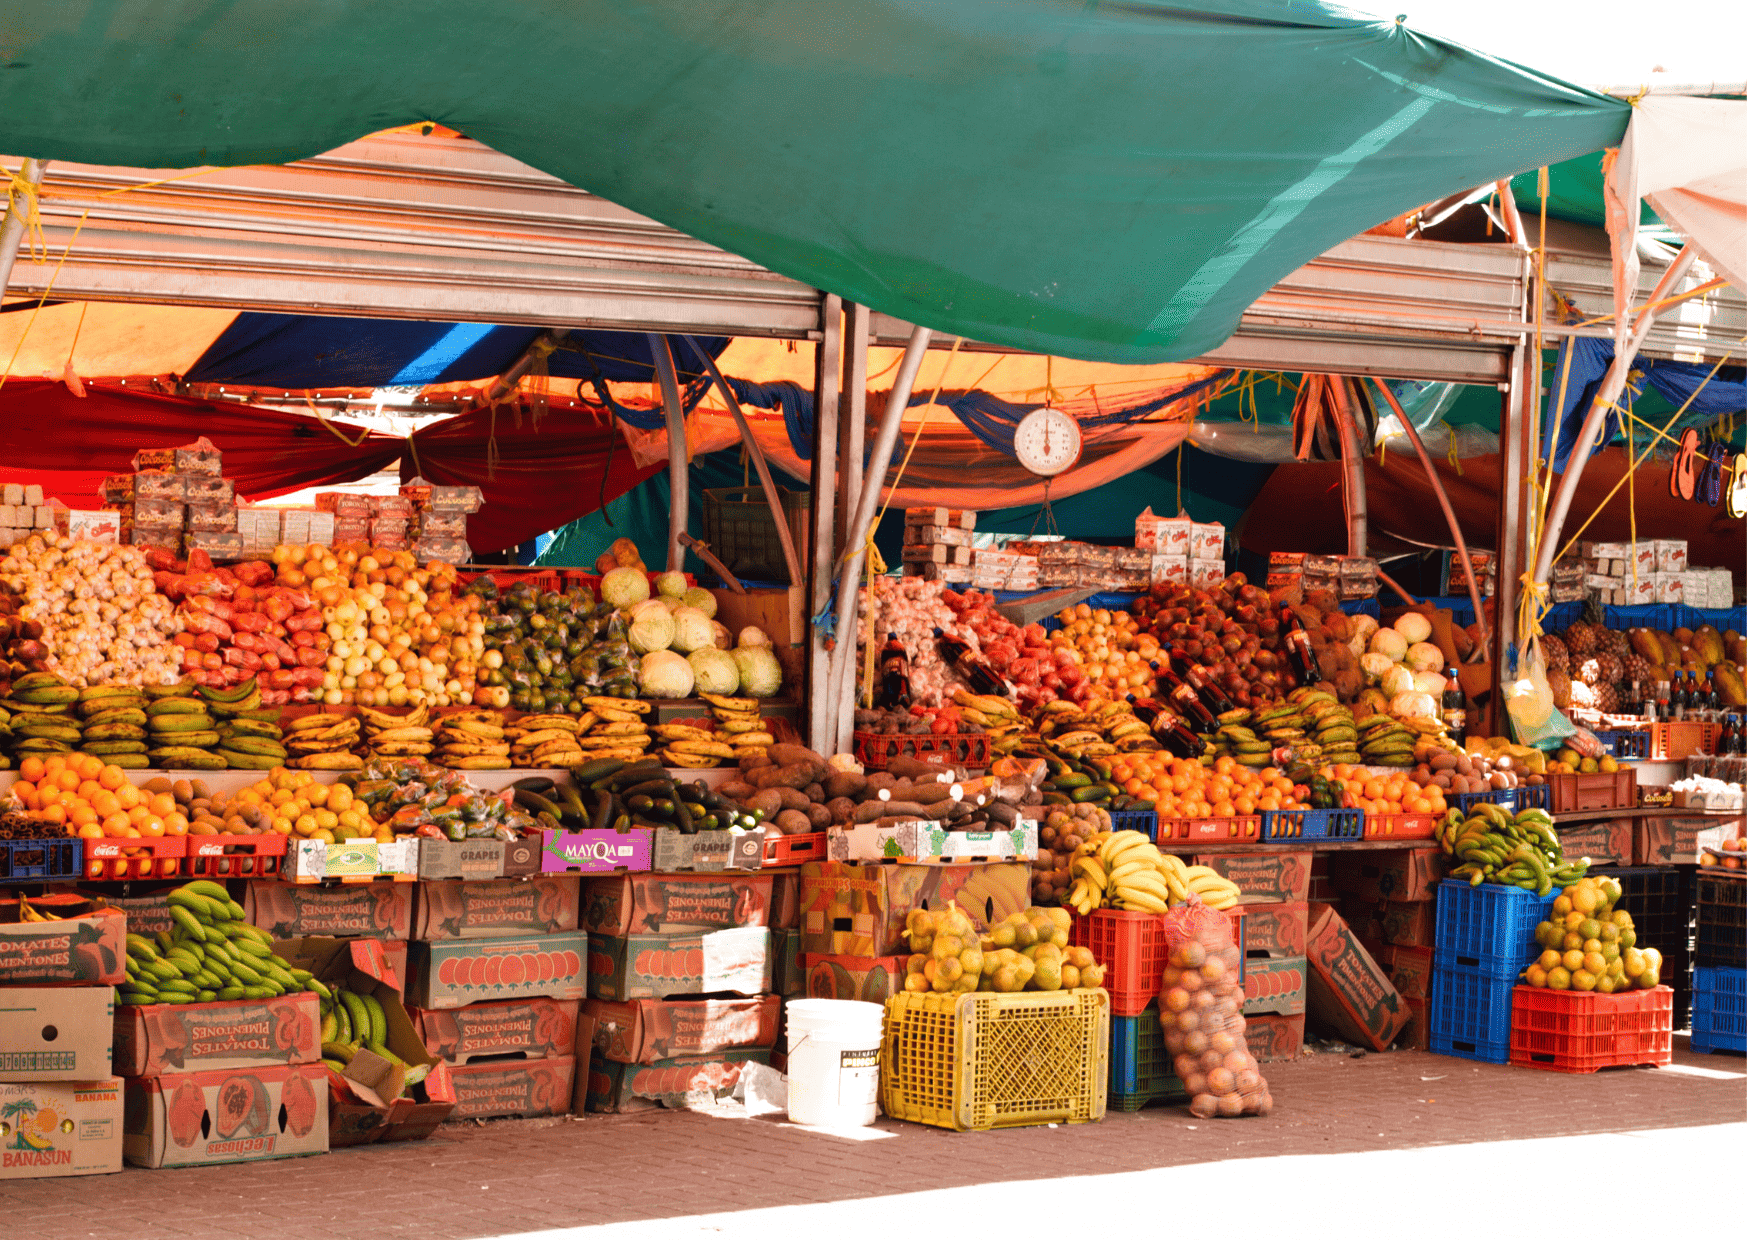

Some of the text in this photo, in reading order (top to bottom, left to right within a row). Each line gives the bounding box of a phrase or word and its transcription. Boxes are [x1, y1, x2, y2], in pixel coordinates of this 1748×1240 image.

[460, 850, 500, 860] GRAPES
[300, 902, 371, 916] PIMENTONES
[468, 895, 534, 911] PIMENTONES
[668, 896, 731, 910] PIMENTONES
[300, 917, 371, 931] TOMATES
[467, 910, 534, 926] TOMATES
[667, 910, 728, 923] TOMATES
[129, 921, 173, 932] TOMA
[0, 935, 70, 952] OMATES
[1346, 948, 1385, 1000] TOMATES
[1338, 958, 1378, 1010] PIMENTONES
[192, 1022, 270, 1040] PIMENTONES
[464, 1020, 531, 1037] PIMENTONES
[192, 1037, 270, 1056] TOMATES
[463, 1033, 531, 1051] TOMATES
[75, 1093, 117, 1102] BANANA
[458, 1084, 528, 1101] PIMENTONES
[458, 1099, 528, 1115] TOMATES
[207, 1135, 274, 1154] Lechosas
[2, 1150, 72, 1168] BANASUN
